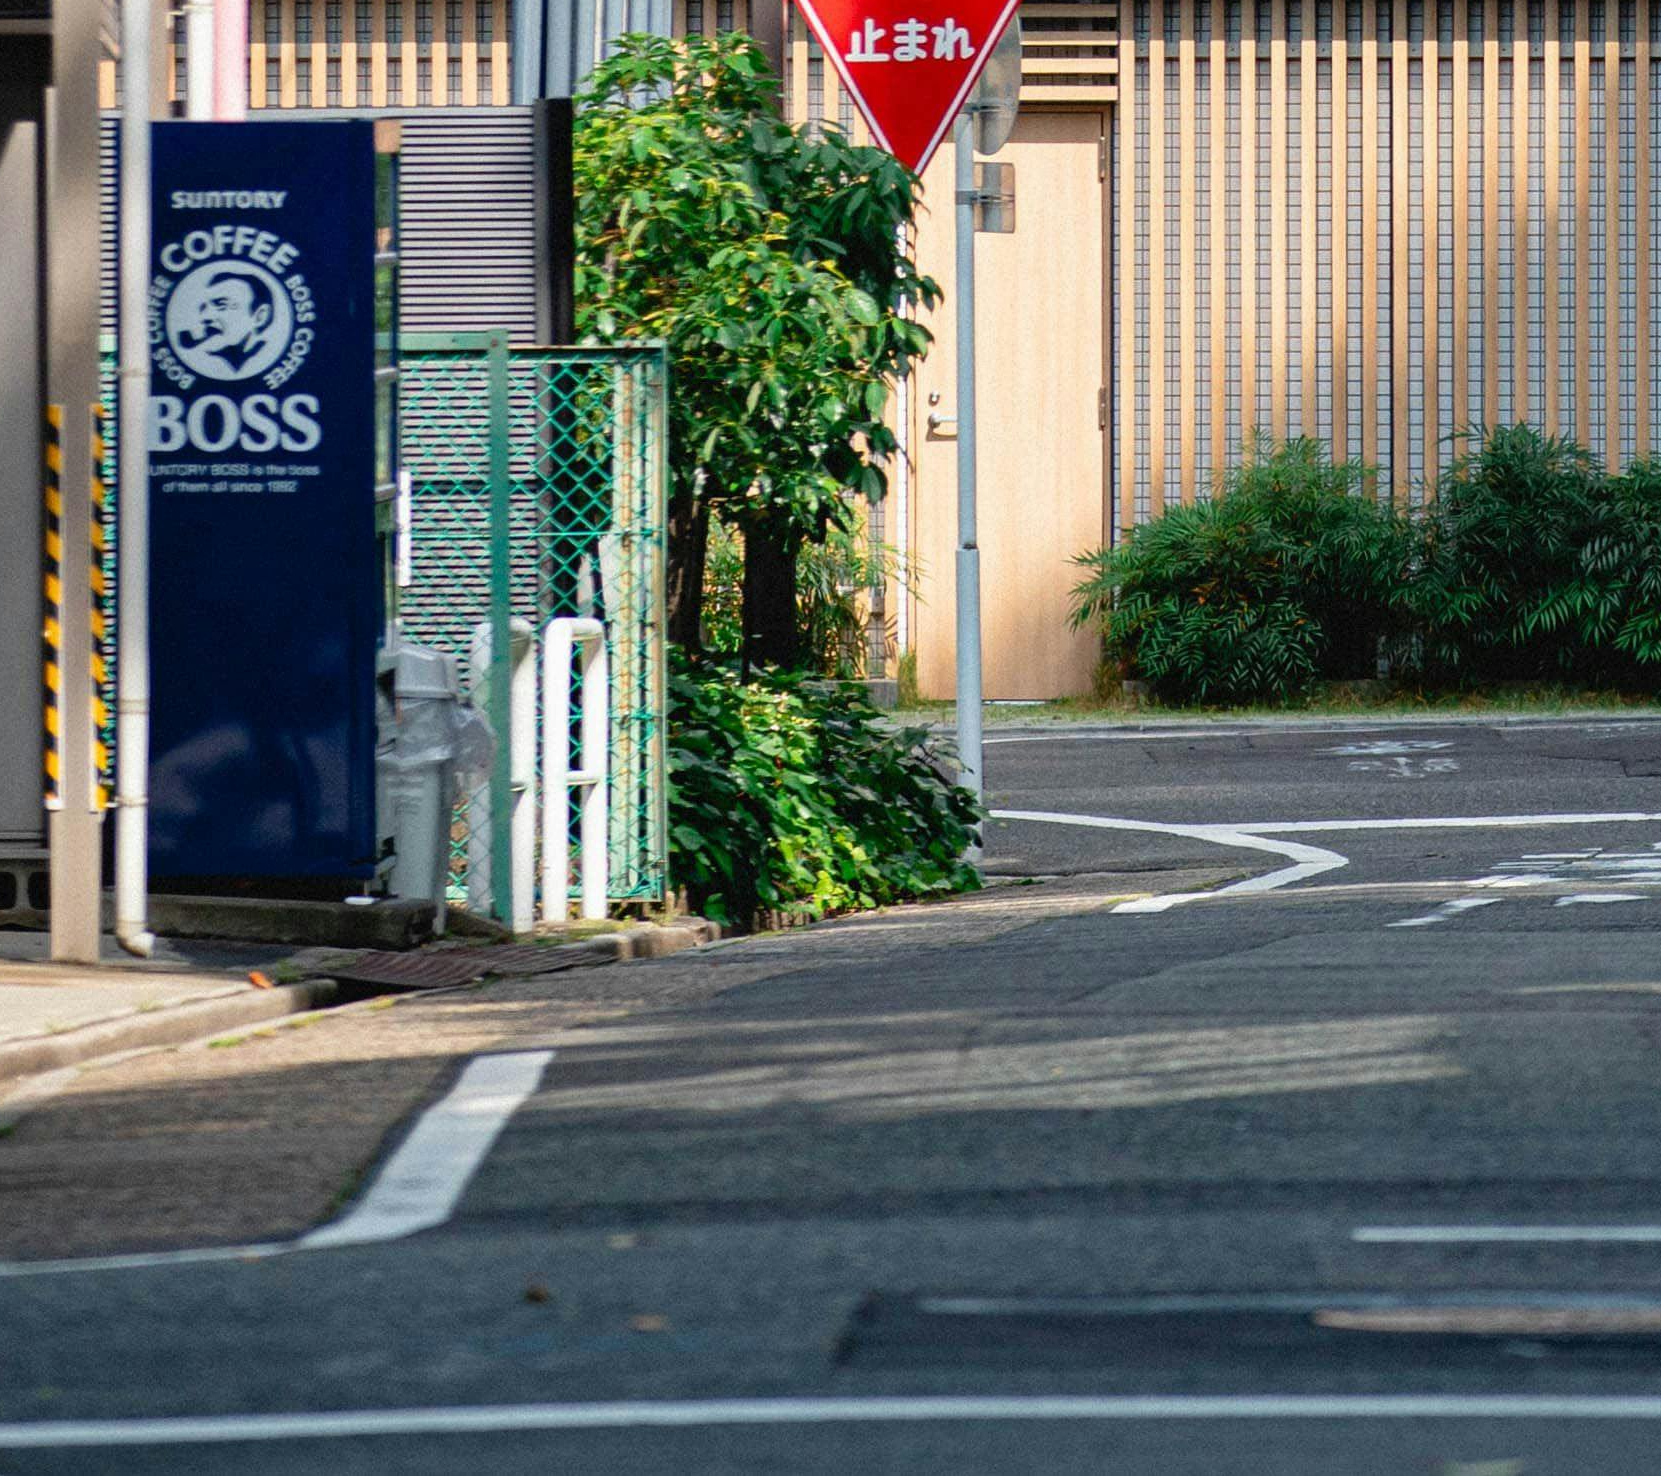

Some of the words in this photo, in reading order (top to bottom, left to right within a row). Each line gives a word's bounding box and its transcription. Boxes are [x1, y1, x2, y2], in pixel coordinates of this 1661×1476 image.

[844, 17, 976, 63] 止まれ
[171, 190, 288, 209] SUNTORY
[160, 225, 300, 275] COFFEE
[284, 273, 317, 323] BOSS
[148, 394, 322, 452] BOSS
